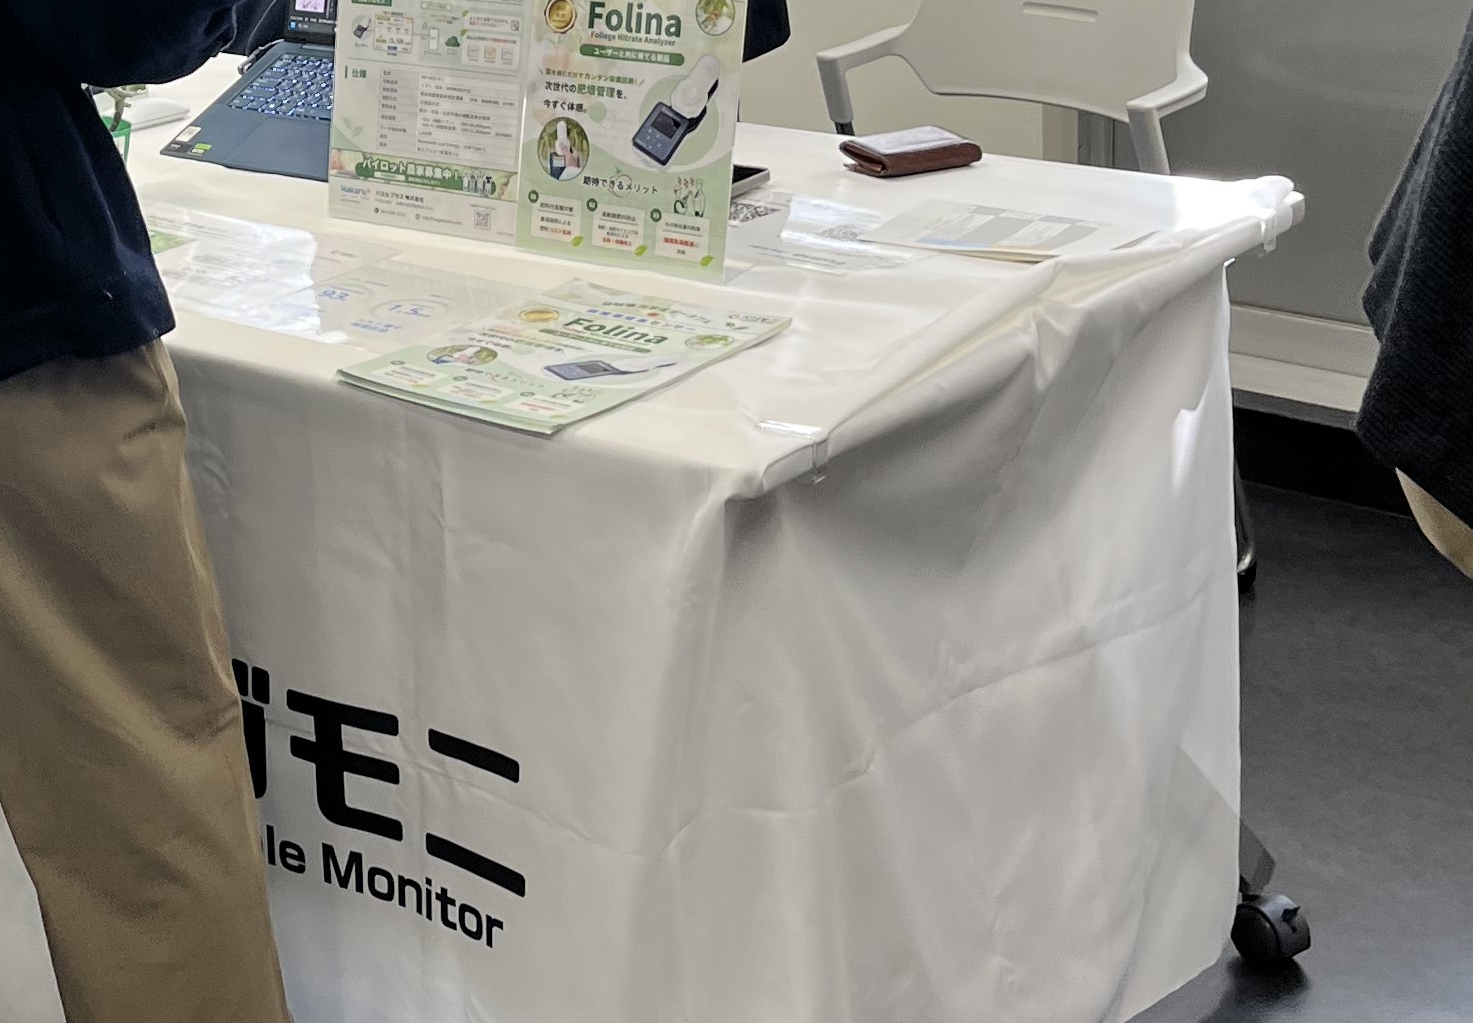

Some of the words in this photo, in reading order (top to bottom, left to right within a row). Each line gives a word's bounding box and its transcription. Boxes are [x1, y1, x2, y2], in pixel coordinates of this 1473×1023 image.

[588, 0, 682, 38] Folina
[591, 31, 616, 42] Foliage
[644, 35, 676, 47] Analyzer
[543, 99, 587, 113] 今すぐ体感。
[582, 176, 658, 195] 期待できるメリット
[562, 317, 669, 345] Folina
[260, 824, 307, 874] le
[322, 843, 504, 949] Monitor
